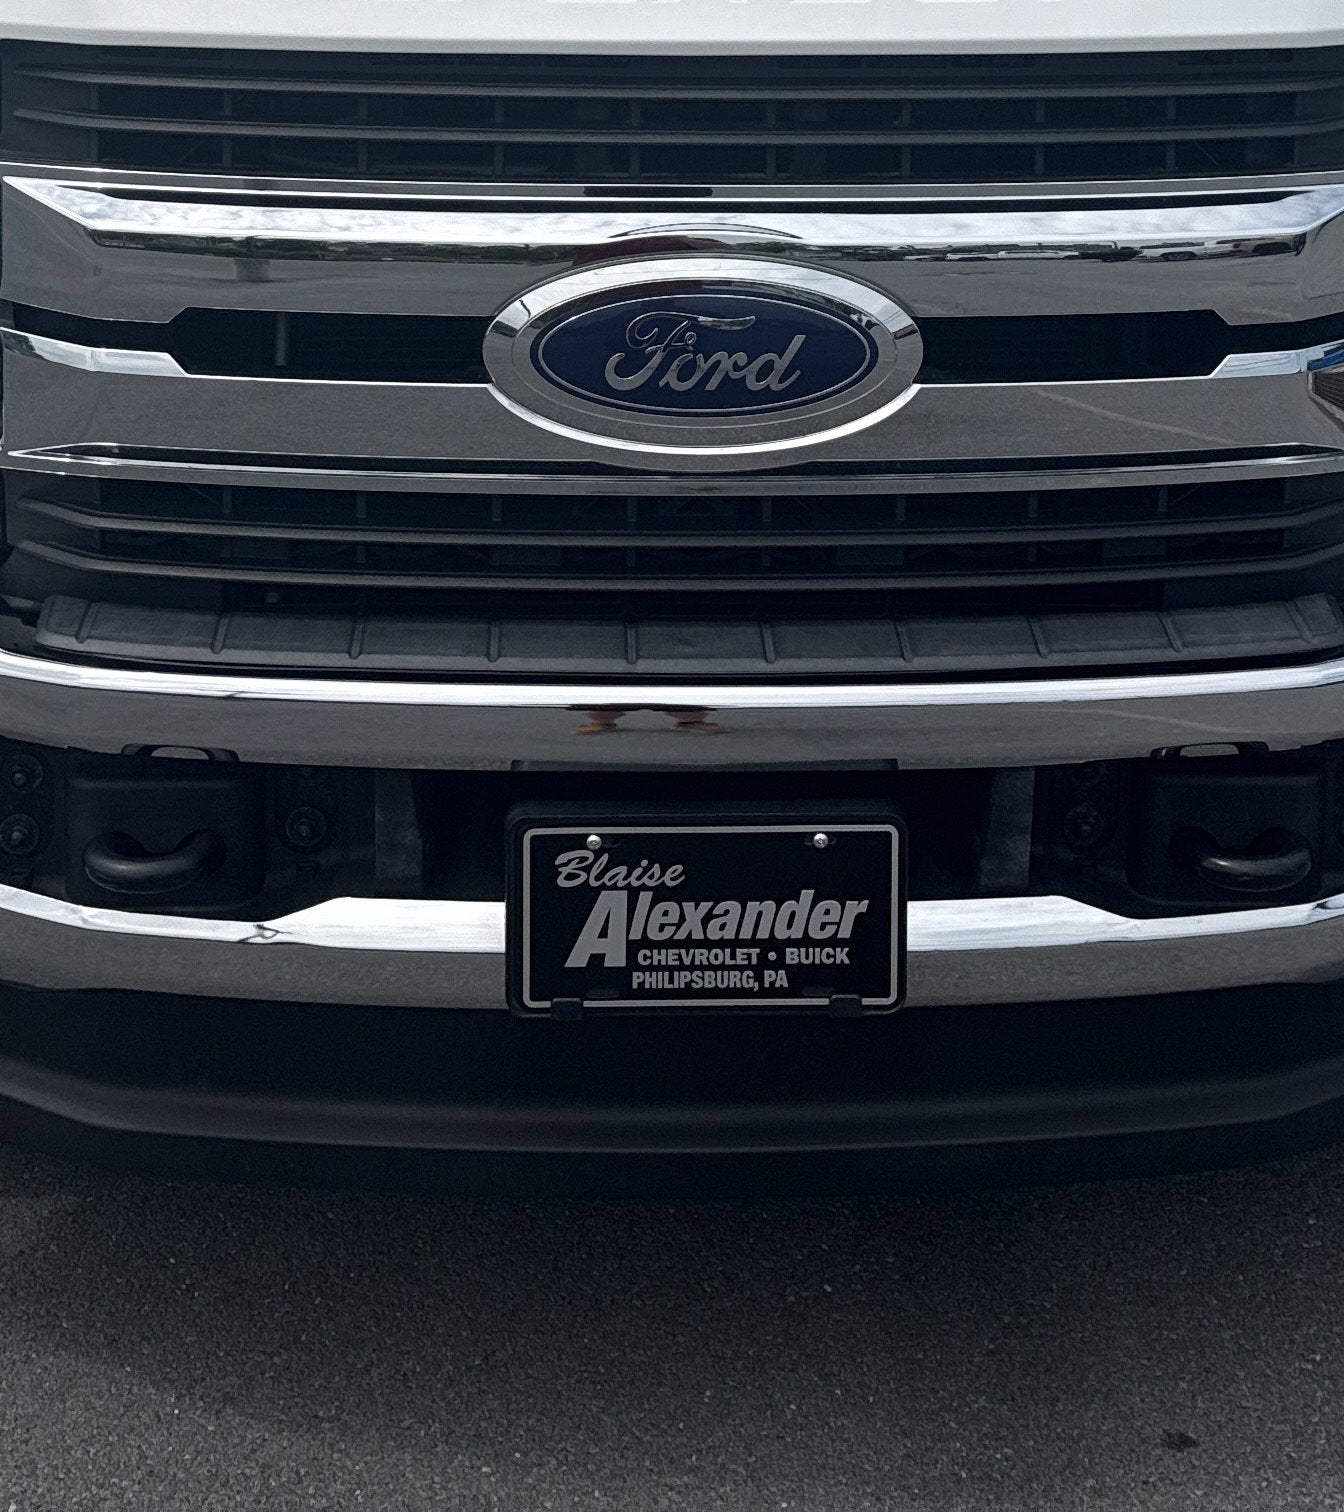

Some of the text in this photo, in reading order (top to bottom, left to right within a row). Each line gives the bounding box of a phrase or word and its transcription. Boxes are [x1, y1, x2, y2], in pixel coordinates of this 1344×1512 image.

[604, 310, 806, 392] Ford
[554, 849, 686, 888] Blaise
[564, 889, 869, 968] Alexander
[637, 947, 850, 966] CHEVROLET BUICK
[632, 970, 789, 991] PHILIPSBURG, PA
